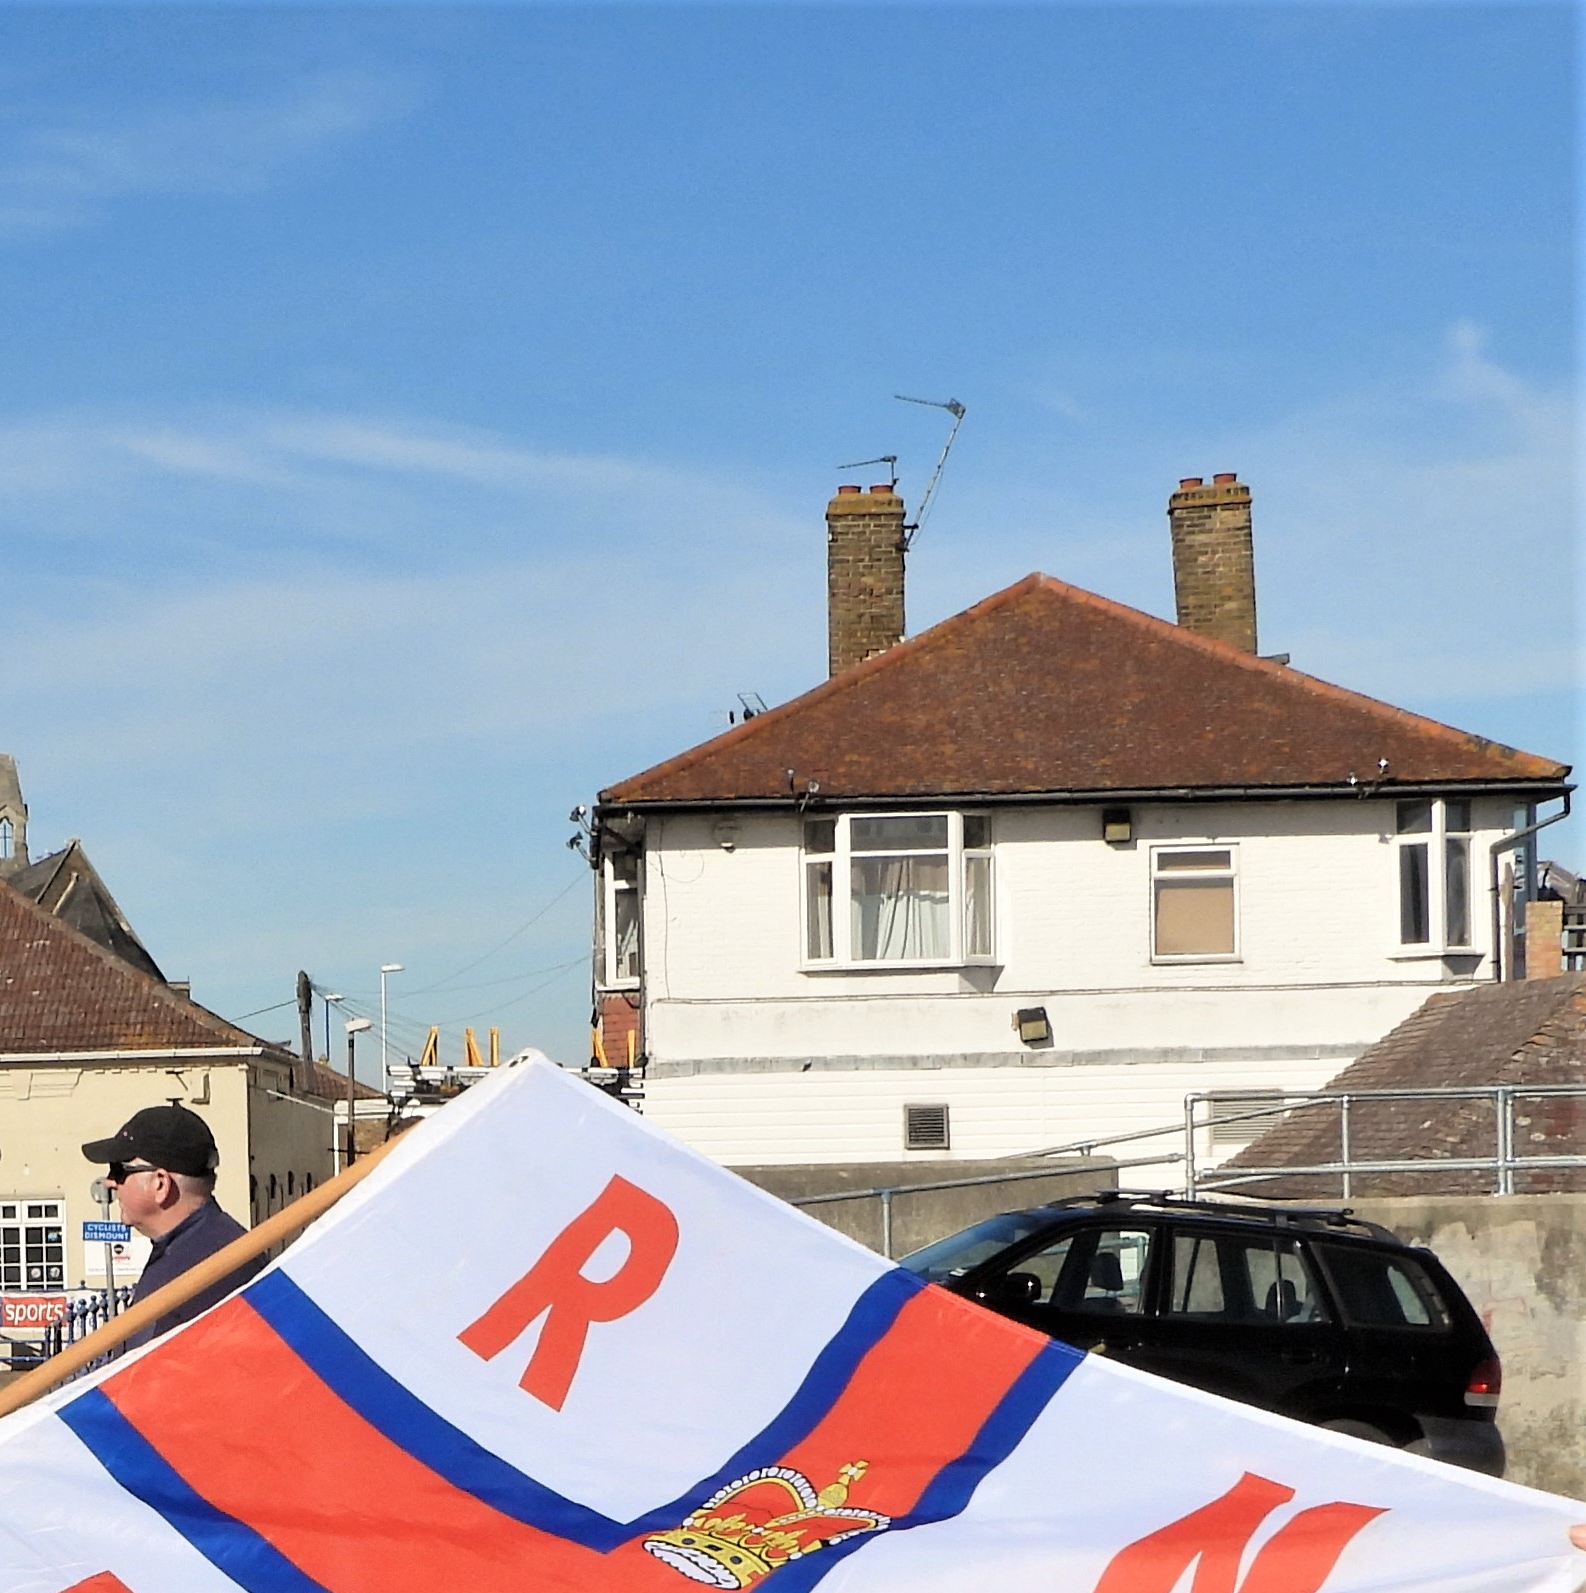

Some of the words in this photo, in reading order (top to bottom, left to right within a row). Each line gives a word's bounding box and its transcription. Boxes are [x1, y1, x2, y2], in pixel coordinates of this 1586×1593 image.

[87, 1223, 127, 1231] CYCLISTS
[84, 1232, 129, 1240] DISMOUNT
[455, 1173, 680, 1413] R
[5, 1303, 64, 1325] sports
